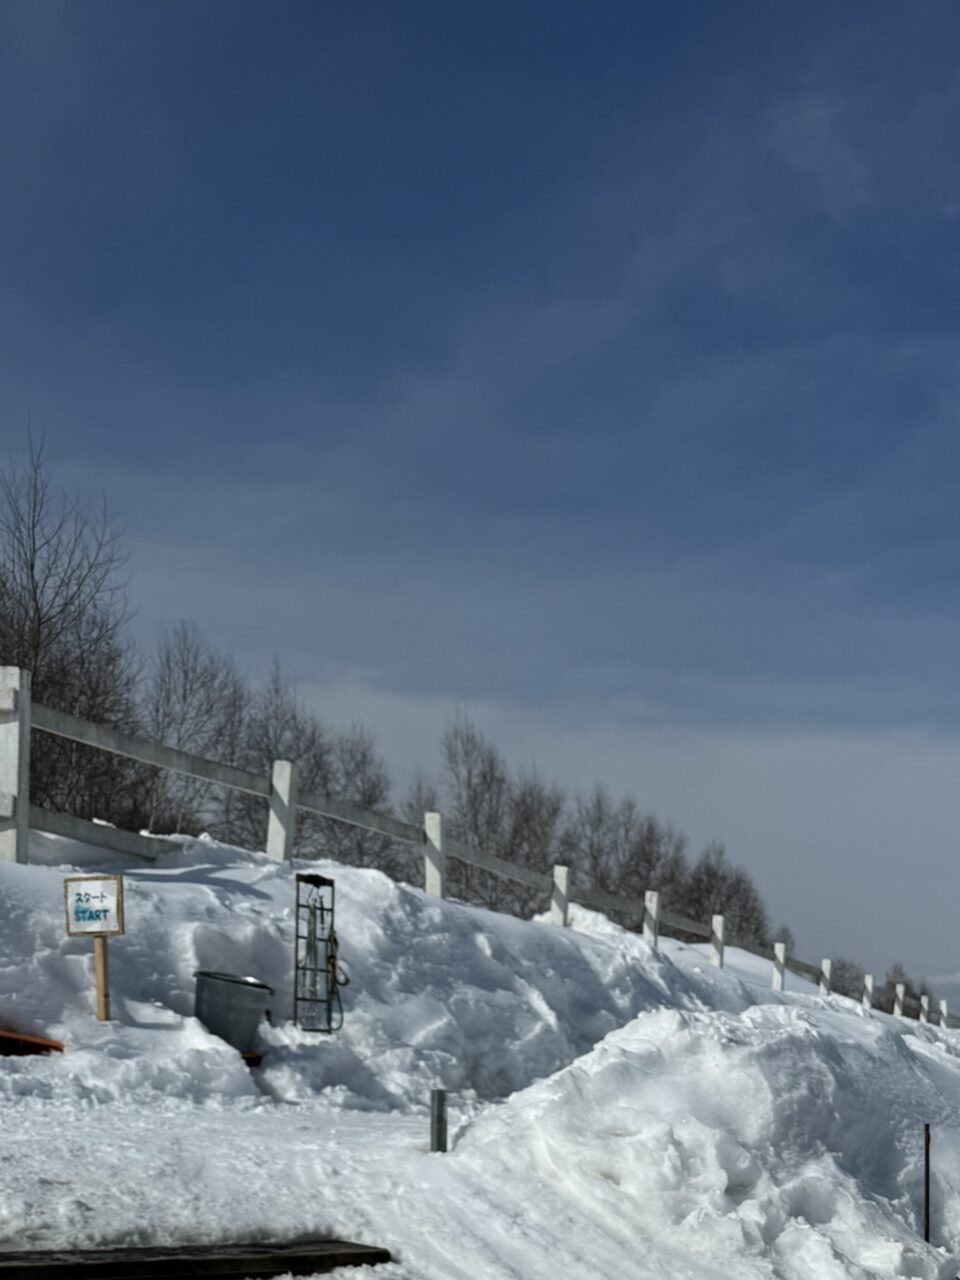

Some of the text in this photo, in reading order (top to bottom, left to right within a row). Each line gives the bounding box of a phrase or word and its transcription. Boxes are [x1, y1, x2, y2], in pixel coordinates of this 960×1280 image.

[75, 891, 107, 904] スタート
[74, 909, 110, 922] START
